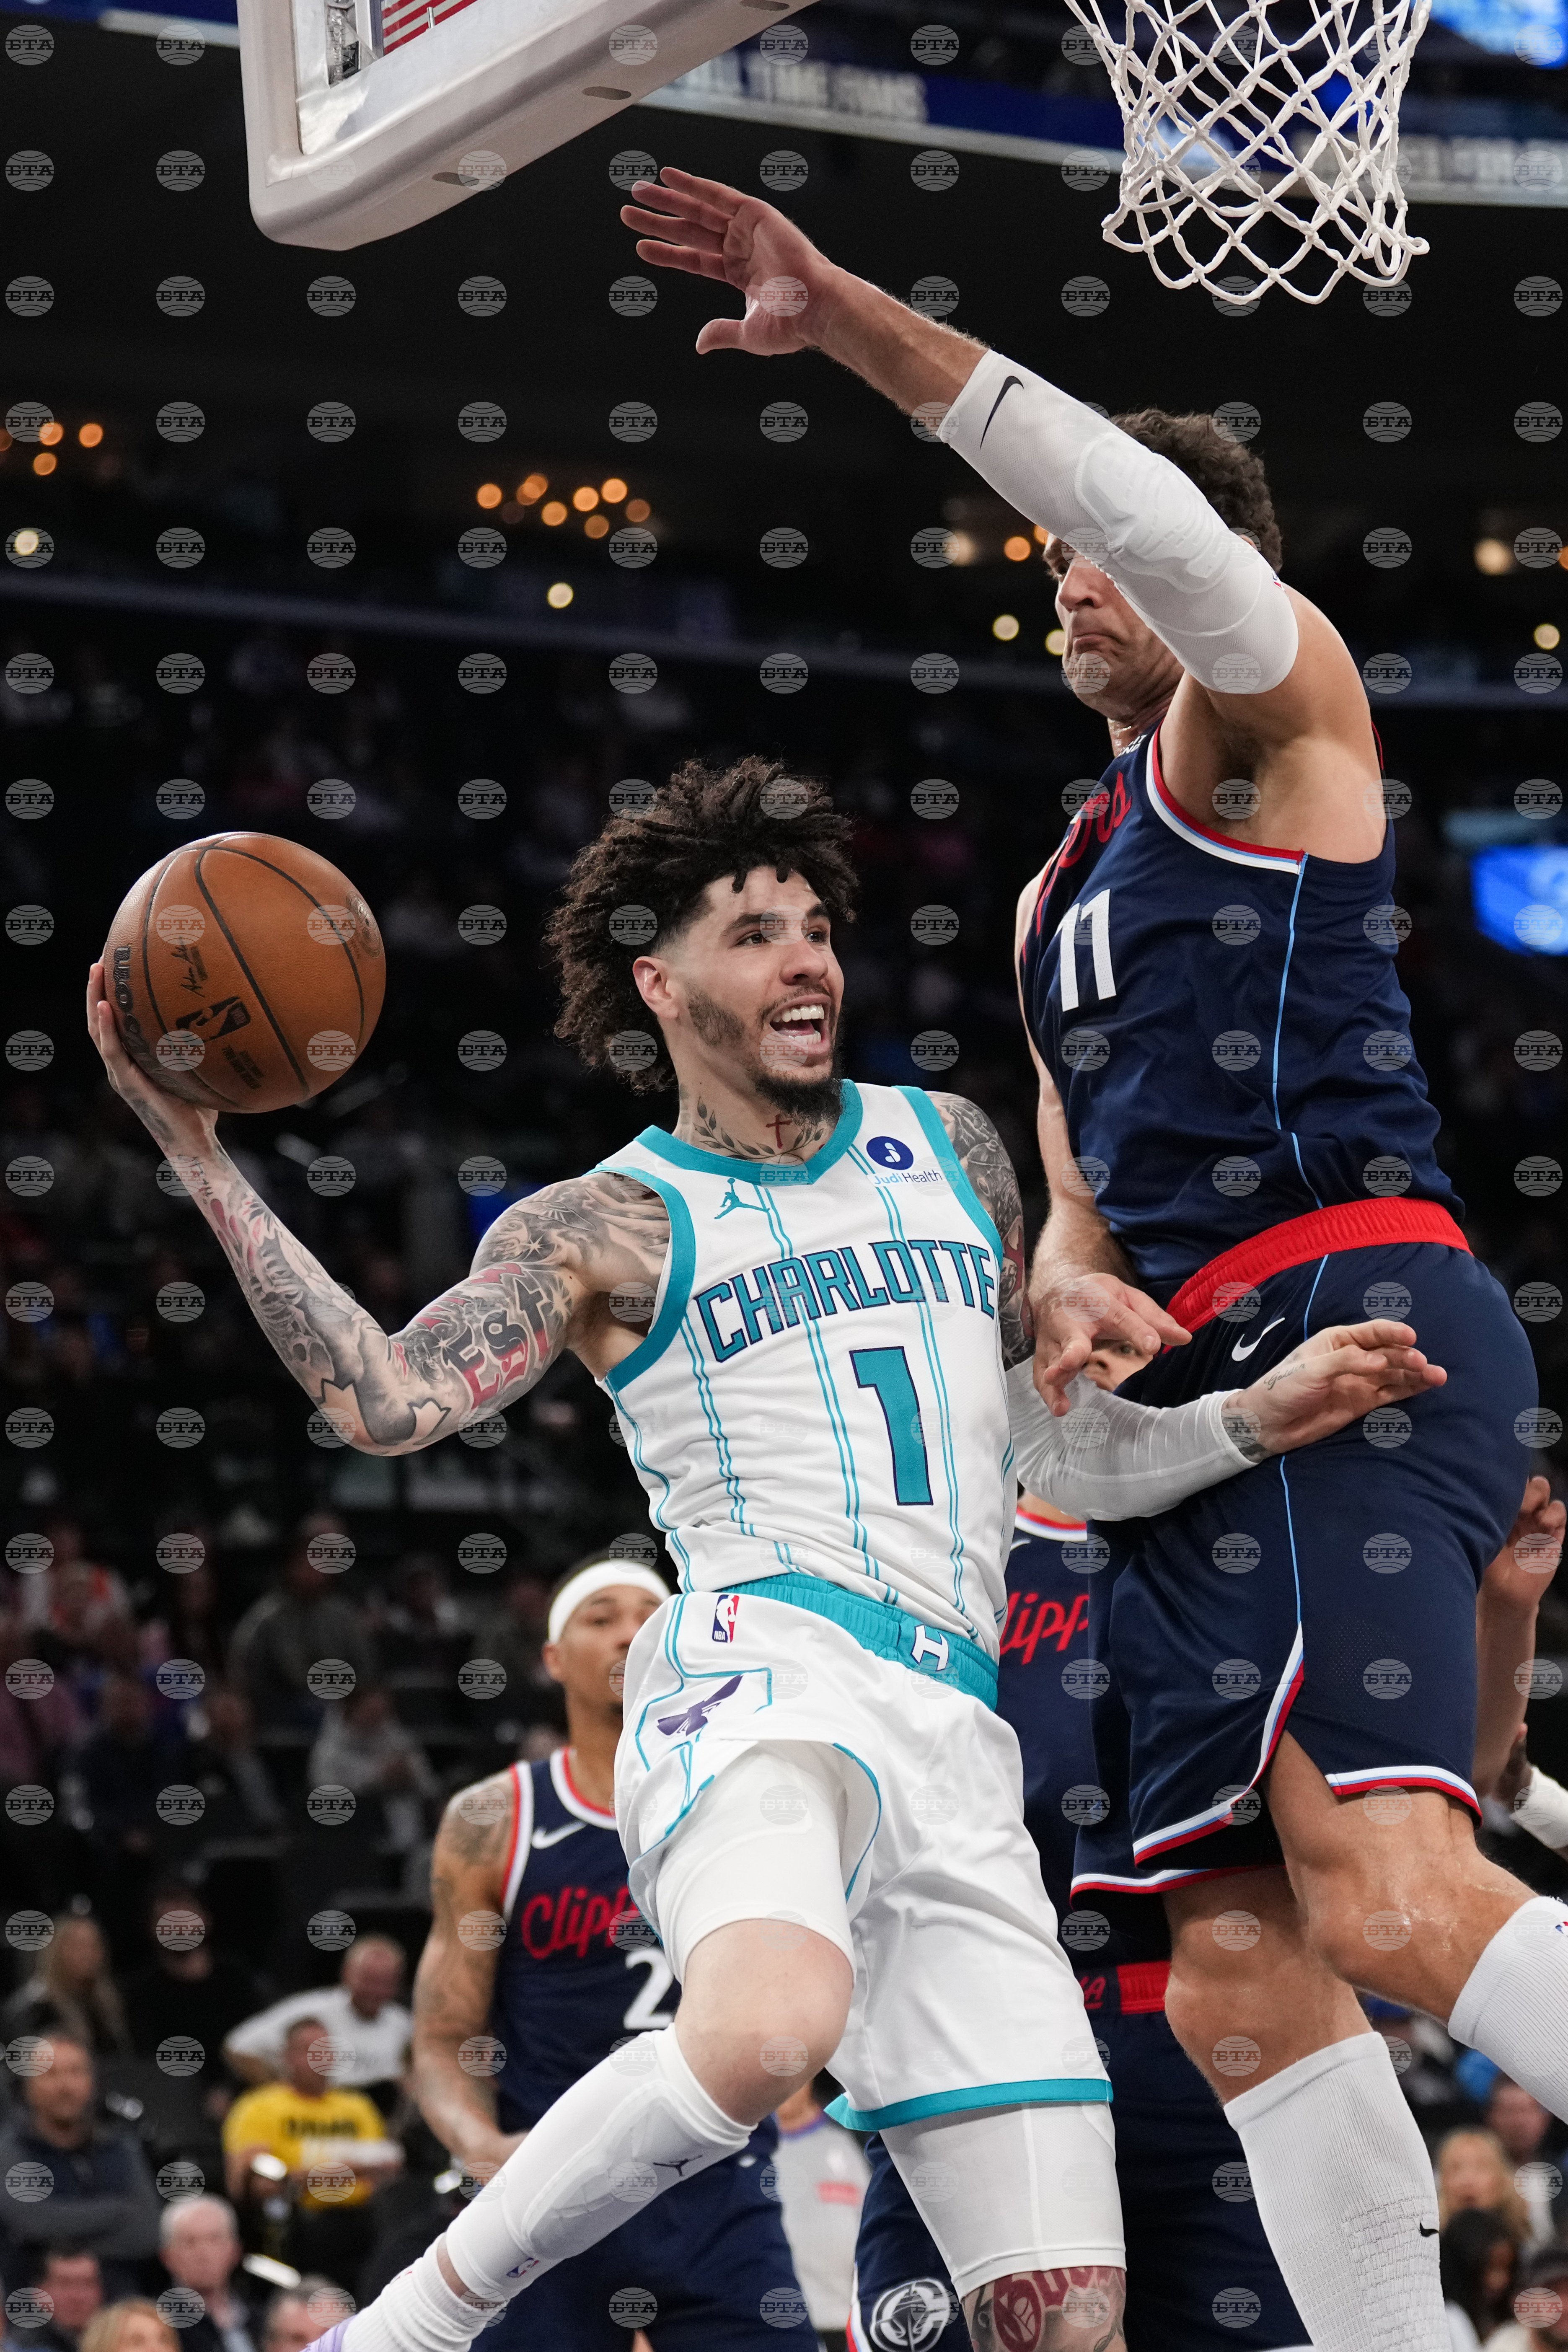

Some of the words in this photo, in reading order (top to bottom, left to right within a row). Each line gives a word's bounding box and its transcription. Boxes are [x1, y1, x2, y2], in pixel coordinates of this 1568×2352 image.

[1054, 888, 1117, 1012] 11
[694, 1239, 996, 1363] CHARLOTTE
[849, 1346, 934, 1506] 1
[714, 1630, 726, 1641] NBA
